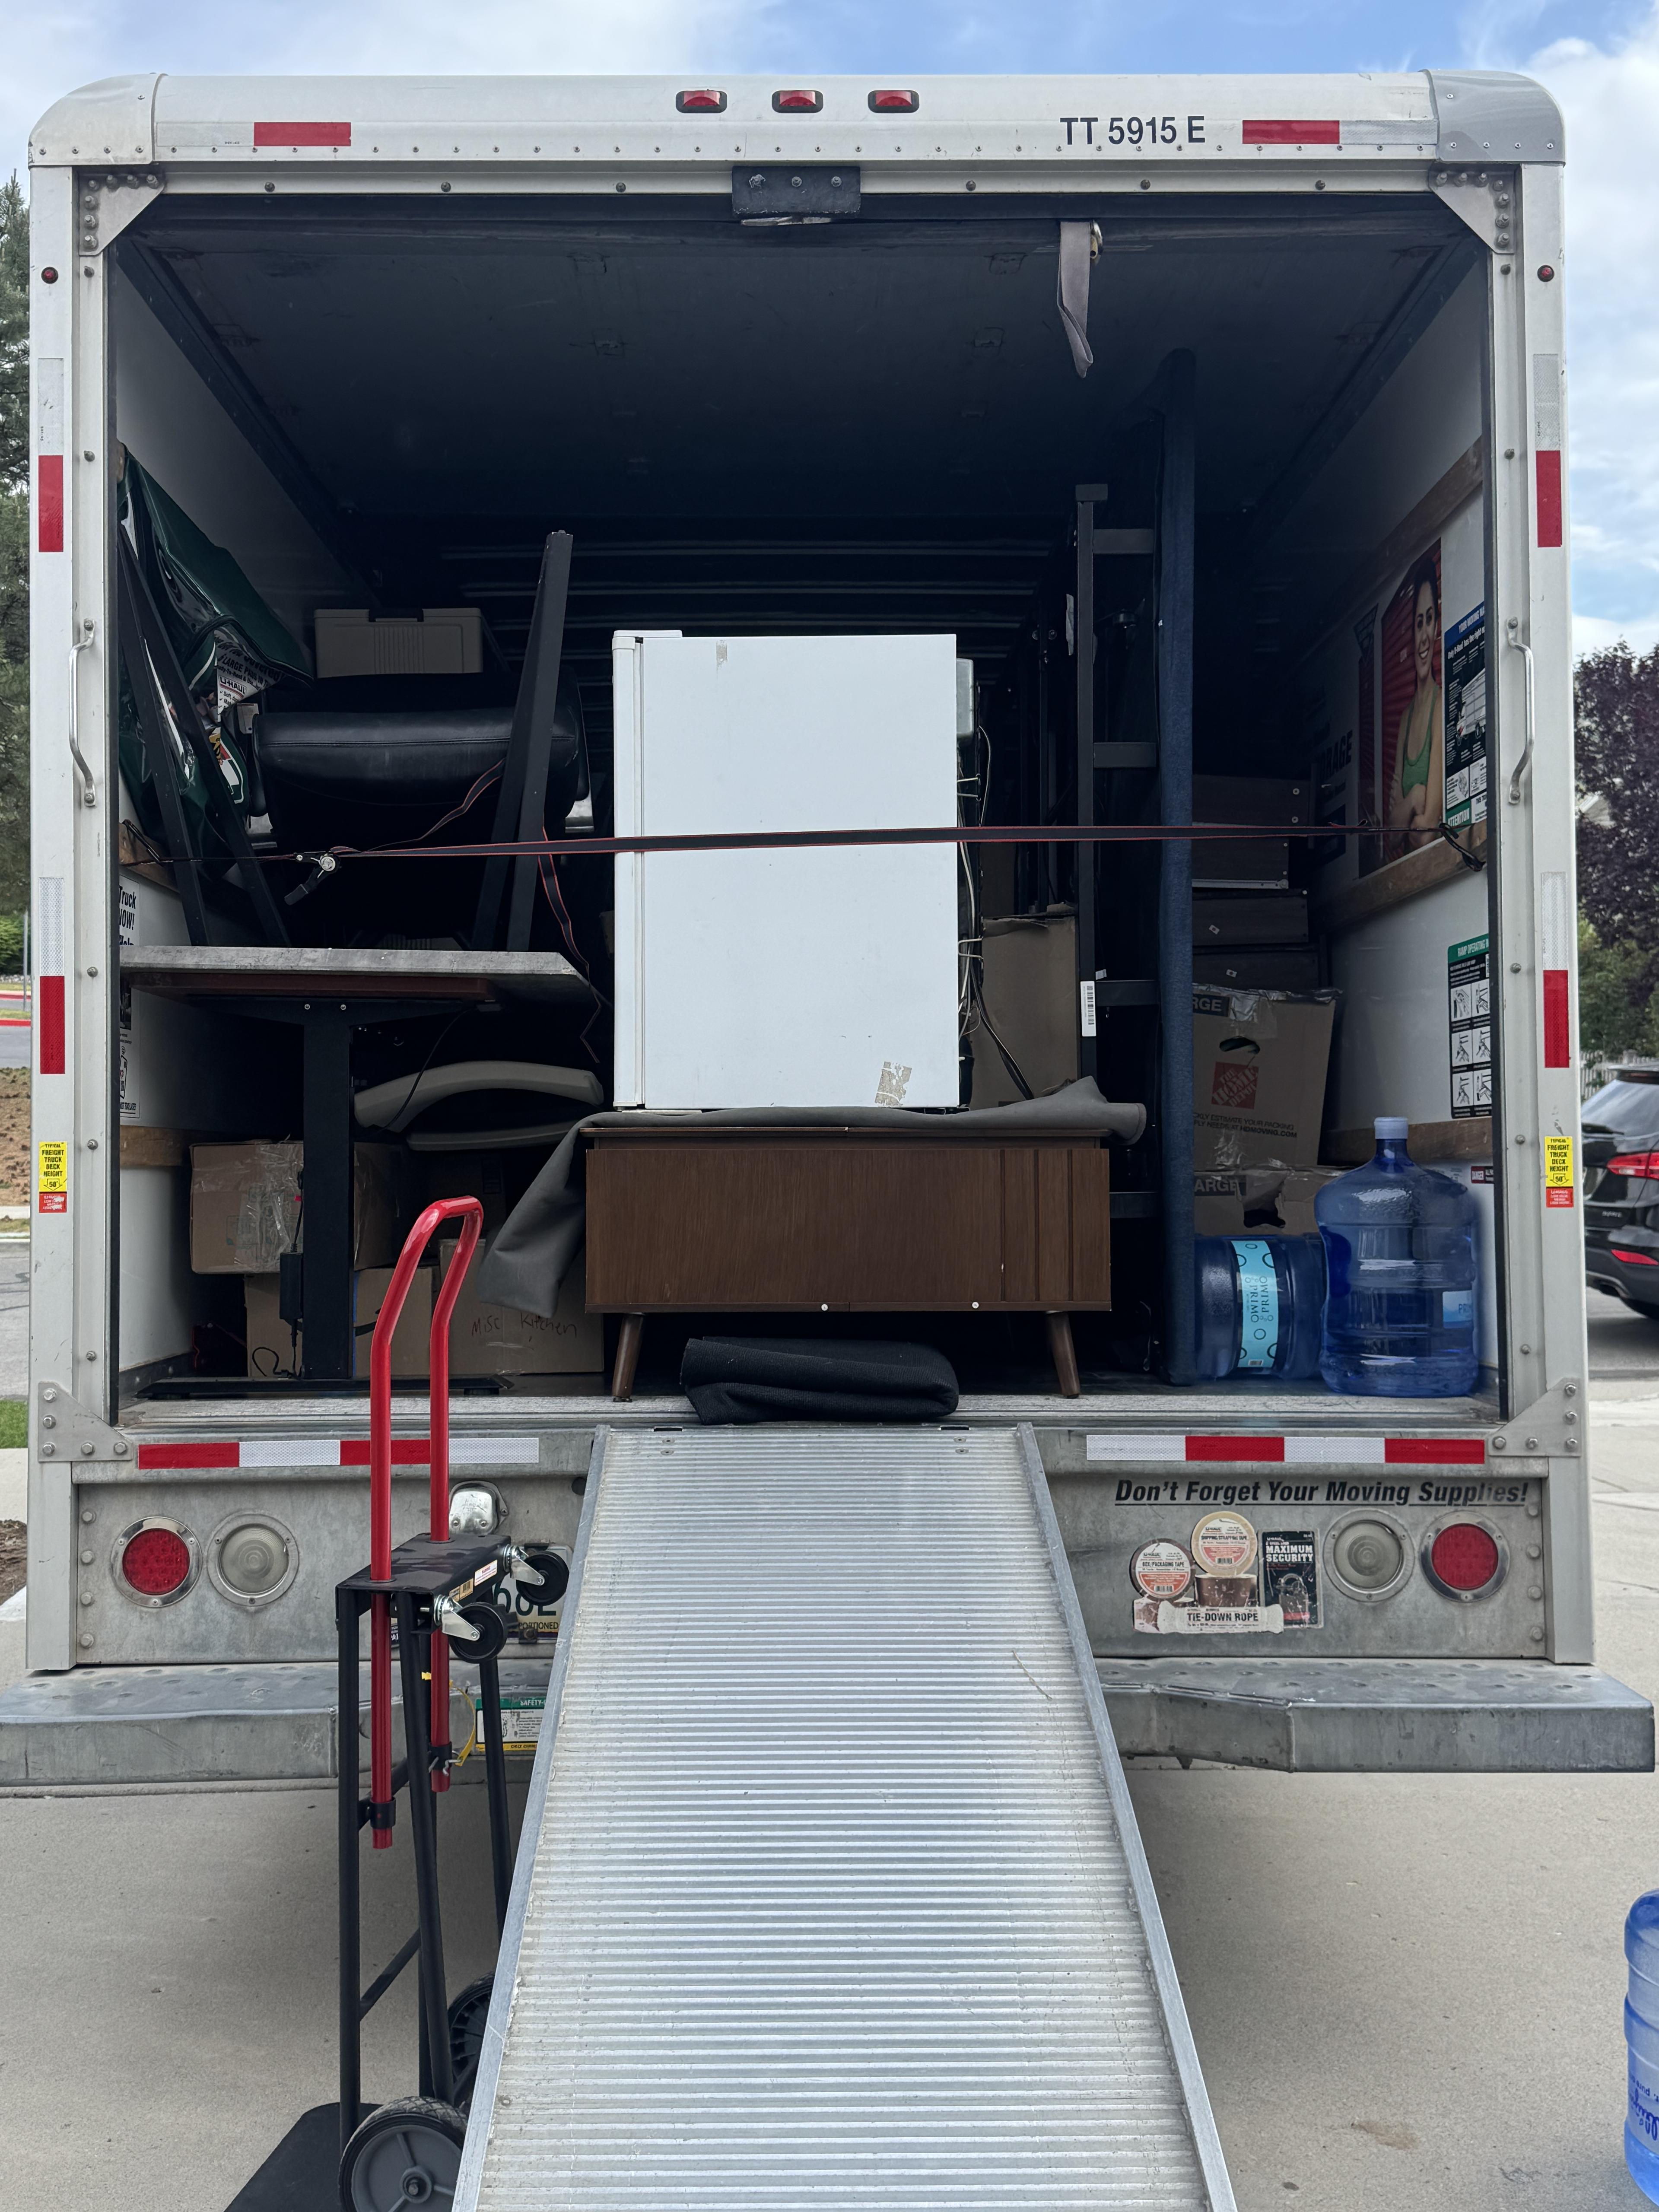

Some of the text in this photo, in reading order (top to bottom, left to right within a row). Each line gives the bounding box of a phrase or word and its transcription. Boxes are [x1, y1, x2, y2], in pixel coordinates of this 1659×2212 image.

[1060, 116, 1205, 145] TT 5915 E
[222, 656, 244, 672] LARGE
[220, 677, 245, 694] U-HAUL
[1211, 1114, 1243, 1124] ESTIMATE
[1239, 1125, 1297, 1138] HDMOVING.COM
[1259, 1276, 1269, 1313] PRIMO
[1251, 1284, 1259, 1323] PRIMO
[1116, 1479, 1529, 1506] Don't Forget Your Moving Supplies!
[1265, 1545, 1313, 1554] MAXIMUM
[1266, 1553, 1313, 1562] SECURITY
[1187, 1613, 1259, 1621] TIE-DOWN ROPE
